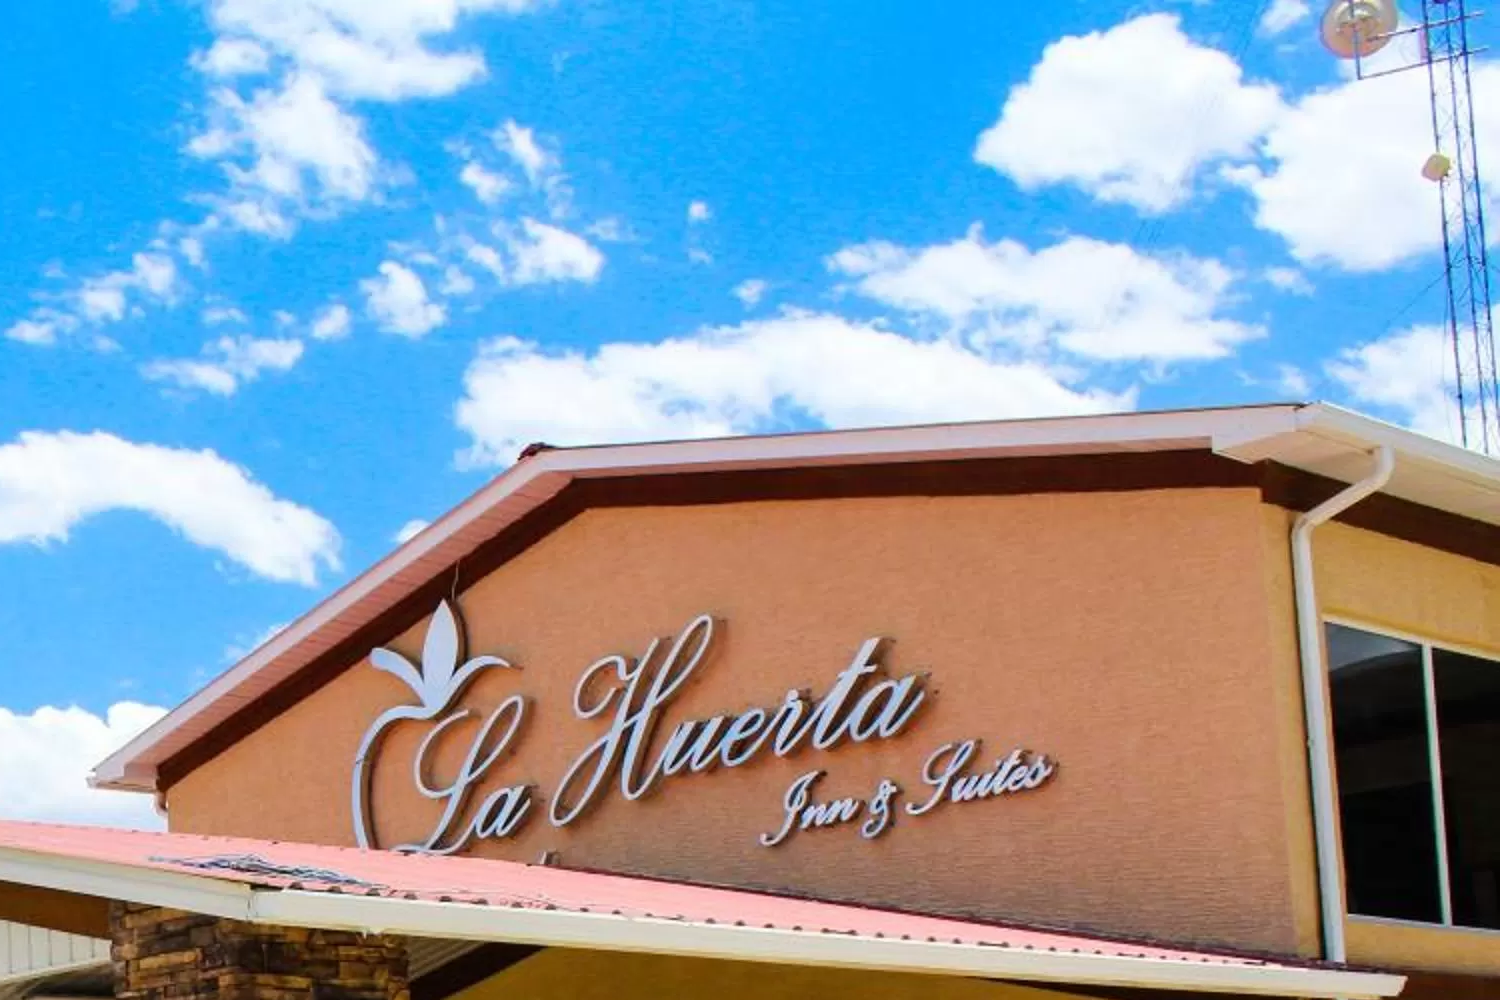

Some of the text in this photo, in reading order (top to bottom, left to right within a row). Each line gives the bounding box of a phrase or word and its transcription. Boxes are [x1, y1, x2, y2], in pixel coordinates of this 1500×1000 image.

[391, 613, 926, 854] La Huerta
[759, 739, 1055, 847] Inn & Suites
